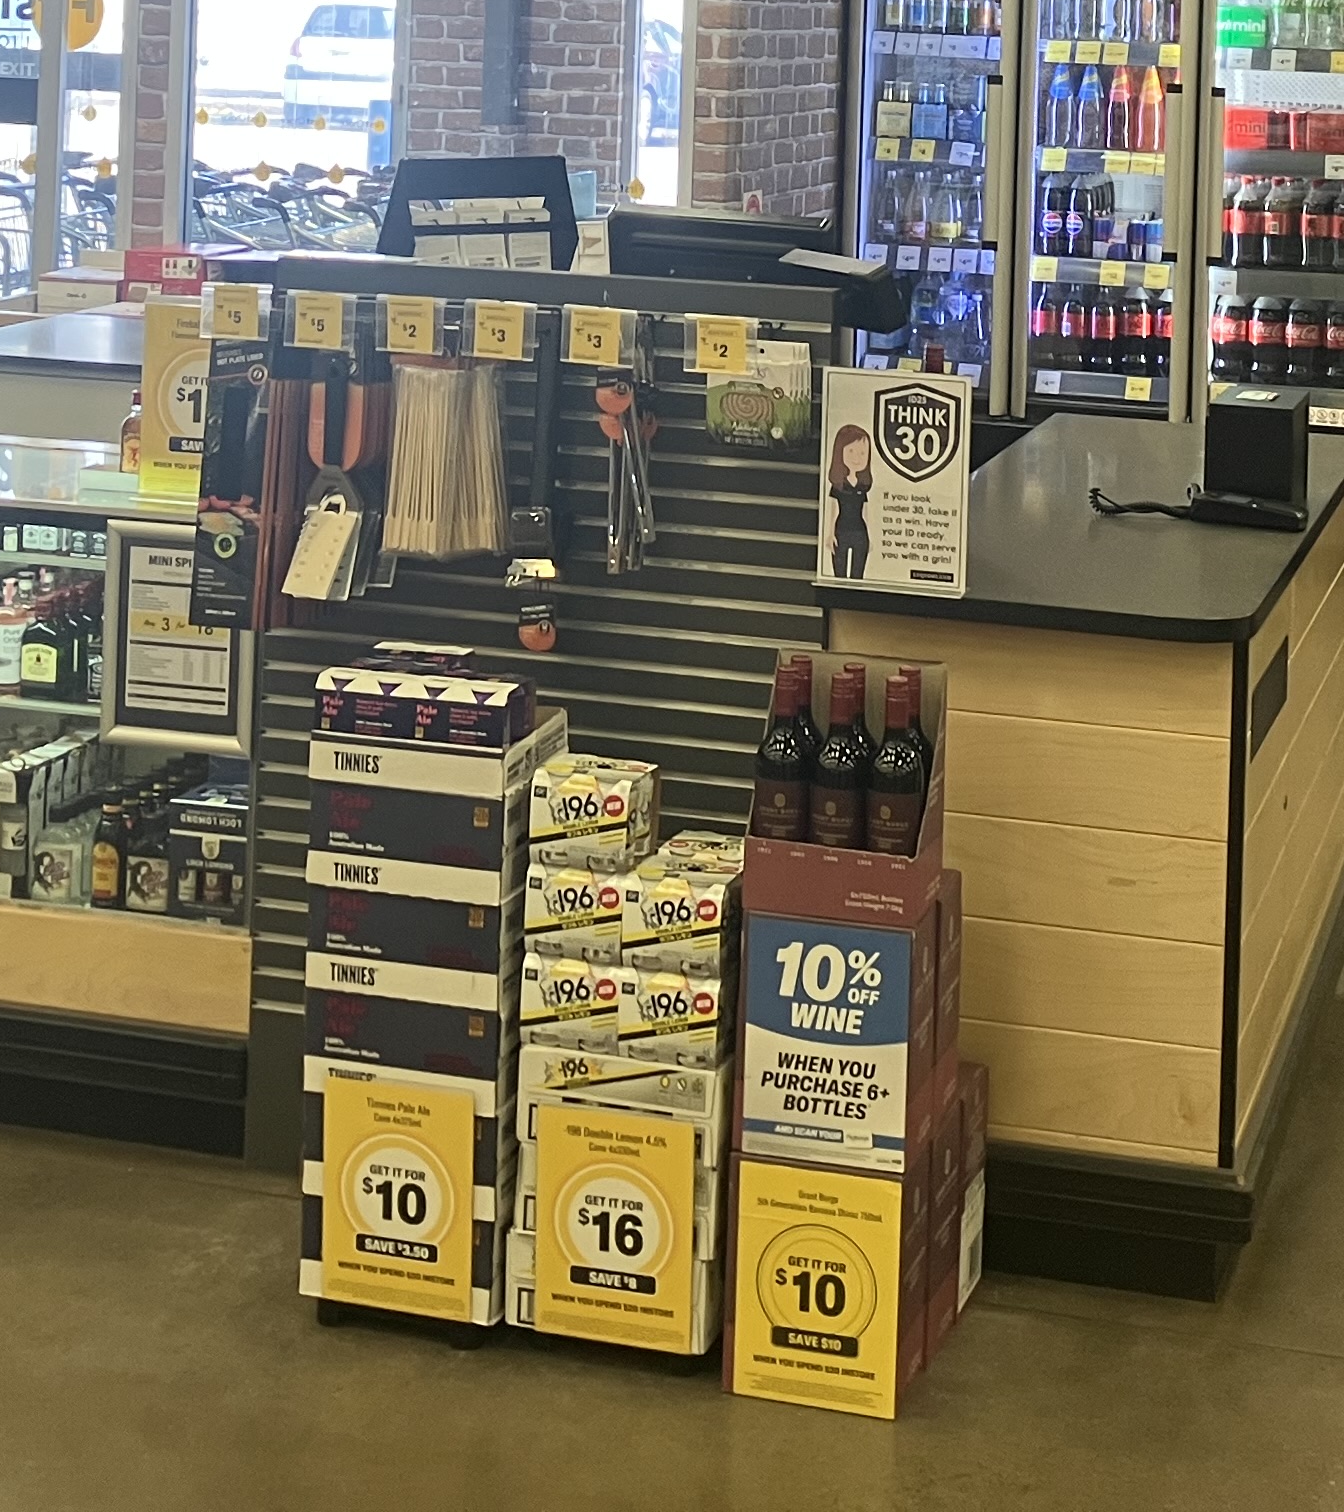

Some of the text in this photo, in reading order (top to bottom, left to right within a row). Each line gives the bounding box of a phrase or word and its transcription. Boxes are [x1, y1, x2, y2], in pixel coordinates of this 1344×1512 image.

[228, 311, 241, 323] $5
[311, 318, 324, 331] $5
[403, 323, 416, 338] $2
[491, 328, 505, 342] $3
[587, 333, 602, 349] $3
[713, 343, 728, 358] $2
[182, 376, 198, 385] GET
[888, 404, 947, 426] THINK
[894, 426, 940, 462] 30
[883, 492, 931, 504] If you look
[883, 505, 909, 514] under
[928, 507, 950, 517] take
[925, 519, 950, 529] Have
[882, 529, 903, 538] your
[905, 529, 915, 537] ID
[882, 540, 956, 553] so we can serve
[149, 555, 172, 566] MINI
[881, 553, 898, 561] you
[901, 552, 920, 562] with
[161, 618, 170, 631] 3
[322, 695, 344, 706] Pale
[323, 705, 337, 716] Ale
[416, 704, 438, 715] Pale
[416, 714, 432, 725] Ale
[334, 751, 380, 774] TINNIES
[334, 862, 379, 885] TINNIES
[330, 962, 376, 986] TINNIES
[847, 988, 880, 1006] OFF
[791, 1002, 864, 1035] WINE
[777, 1051, 877, 1079] WHEN YOU
[760, 1070, 890, 1101] PURCHASE 6+
[774, 1124, 794, 1135] AND
[616, 1131, 643, 1144] Lemon
[370, 1164, 426, 1182] GET IT FOR
[363, 1177, 427, 1225] $10
[585, 1194, 643, 1212] GET IT FOR
[578, 1207, 644, 1257] $16
[365, 1238, 429, 1260] SAVE $3.50
[788, 1255, 847, 1274] GET IT FOR
[589, 1271, 637, 1290] SAVE $8
[775, 1267, 846, 1318] $10
[788, 1332, 842, 1352] SAVE $10
